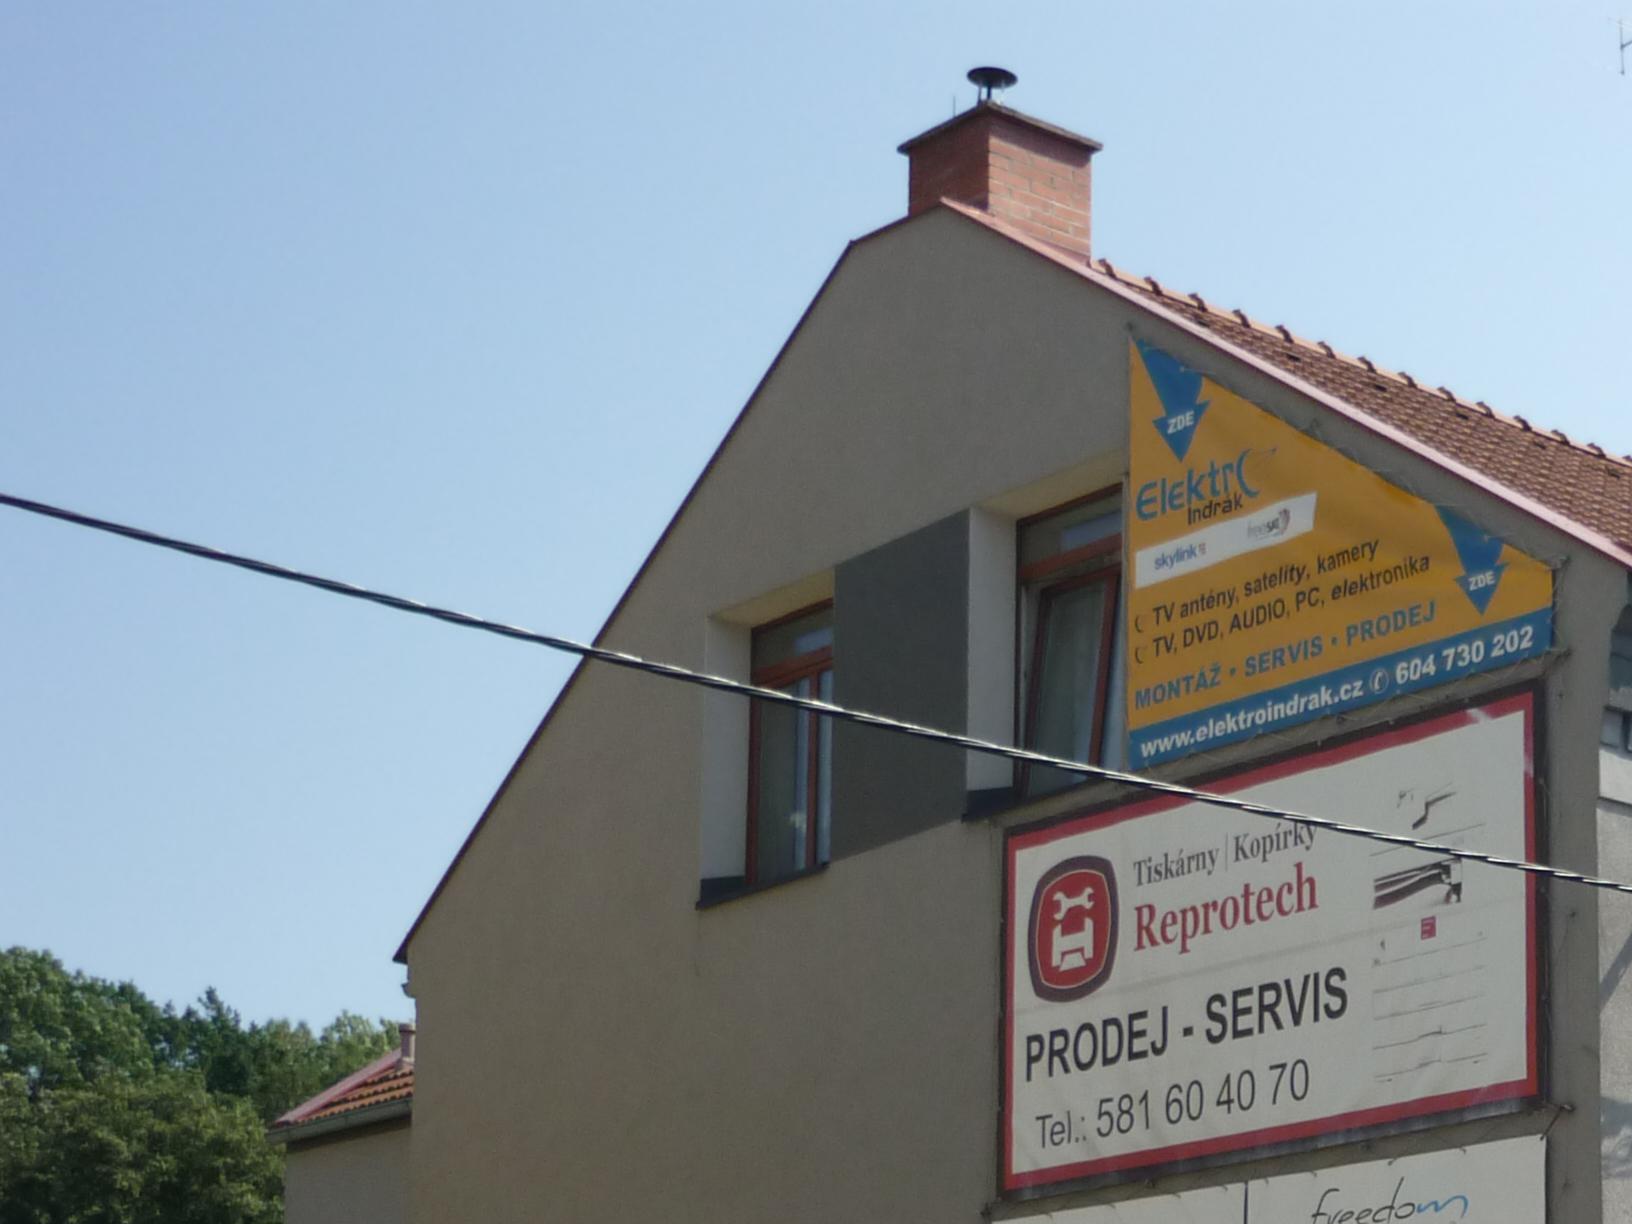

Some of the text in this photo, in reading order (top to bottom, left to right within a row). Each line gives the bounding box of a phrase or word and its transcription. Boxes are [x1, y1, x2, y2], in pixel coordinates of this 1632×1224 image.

[1167, 411, 1195, 434] ZDE
[1153, 539, 1379, 627] TV antény, satelity, kamery
[1154, 544, 1197, 571] skylink
[1468, 571, 1495, 591] ZDE
[1153, 555, 1430, 657] TV, DVD, AUDIO, PC, elektronika
[1135, 601, 1436, 710] MONTÁŽ SERVIS PRODEJ
[1141, 625, 1533, 757] www.elektroindrak.cz 604 730 202
[1133, 822, 1318, 887] Tiskárny Kopírky
[1133, 862, 1319, 955] Reprotech
[1026, 1005, 1169, 1082] PRODEJ
[1205, 966, 1348, 1045] SERVIS
[1035, 1058, 1309, 1149] Tel.: 581 60 40 70
